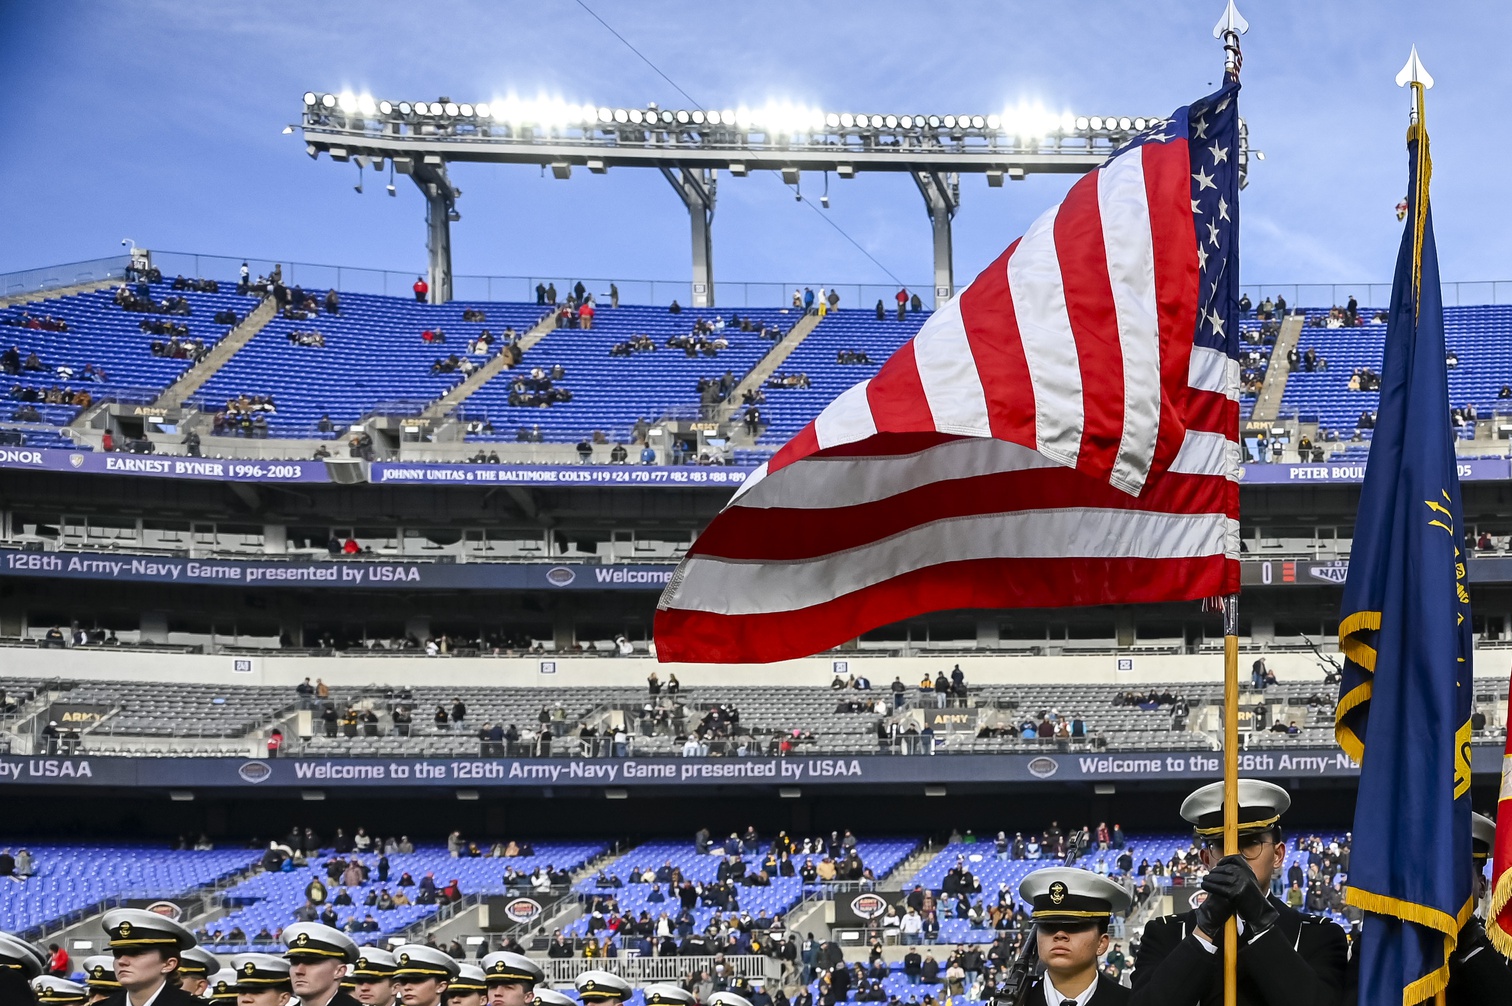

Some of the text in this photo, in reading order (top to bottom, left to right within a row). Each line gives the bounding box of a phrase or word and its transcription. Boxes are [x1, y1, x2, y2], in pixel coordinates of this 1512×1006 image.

[134, 406, 167, 416] ARMY
[400, 419, 430, 427] ARMY
[690, 423, 719, 431] ARMY
[1246, 421, 1275, 430] ARMY
[106, 457, 302, 478] EARNEST BYNER 1996-2003
[1290, 466, 1366, 479] PETER BOUL
[382, 469, 746, 482] JOHNNY UNITAS & THE BALTIMORE COLTS #19 #24 #70 #77 #82 #83 #88 #89
[7, 553, 421, 584] 126th Army-Navy Game presented by USAA
[1262, 561, 1272, 584] 0
[1319, 569, 1347, 580] NAV
[595, 567, 673, 584] Welcome
[62, 711, 101, 722] ARMY
[933, 714, 969, 724] ARMY
[1238, 712, 1254, 721] RM
[29, 760, 92, 778] USAA
[1080, 754, 1360, 773] Welcome to the 26th Army-Na
[294, 760, 863, 782] Welcome to the 126th Army-Navy Game presented by USAA
